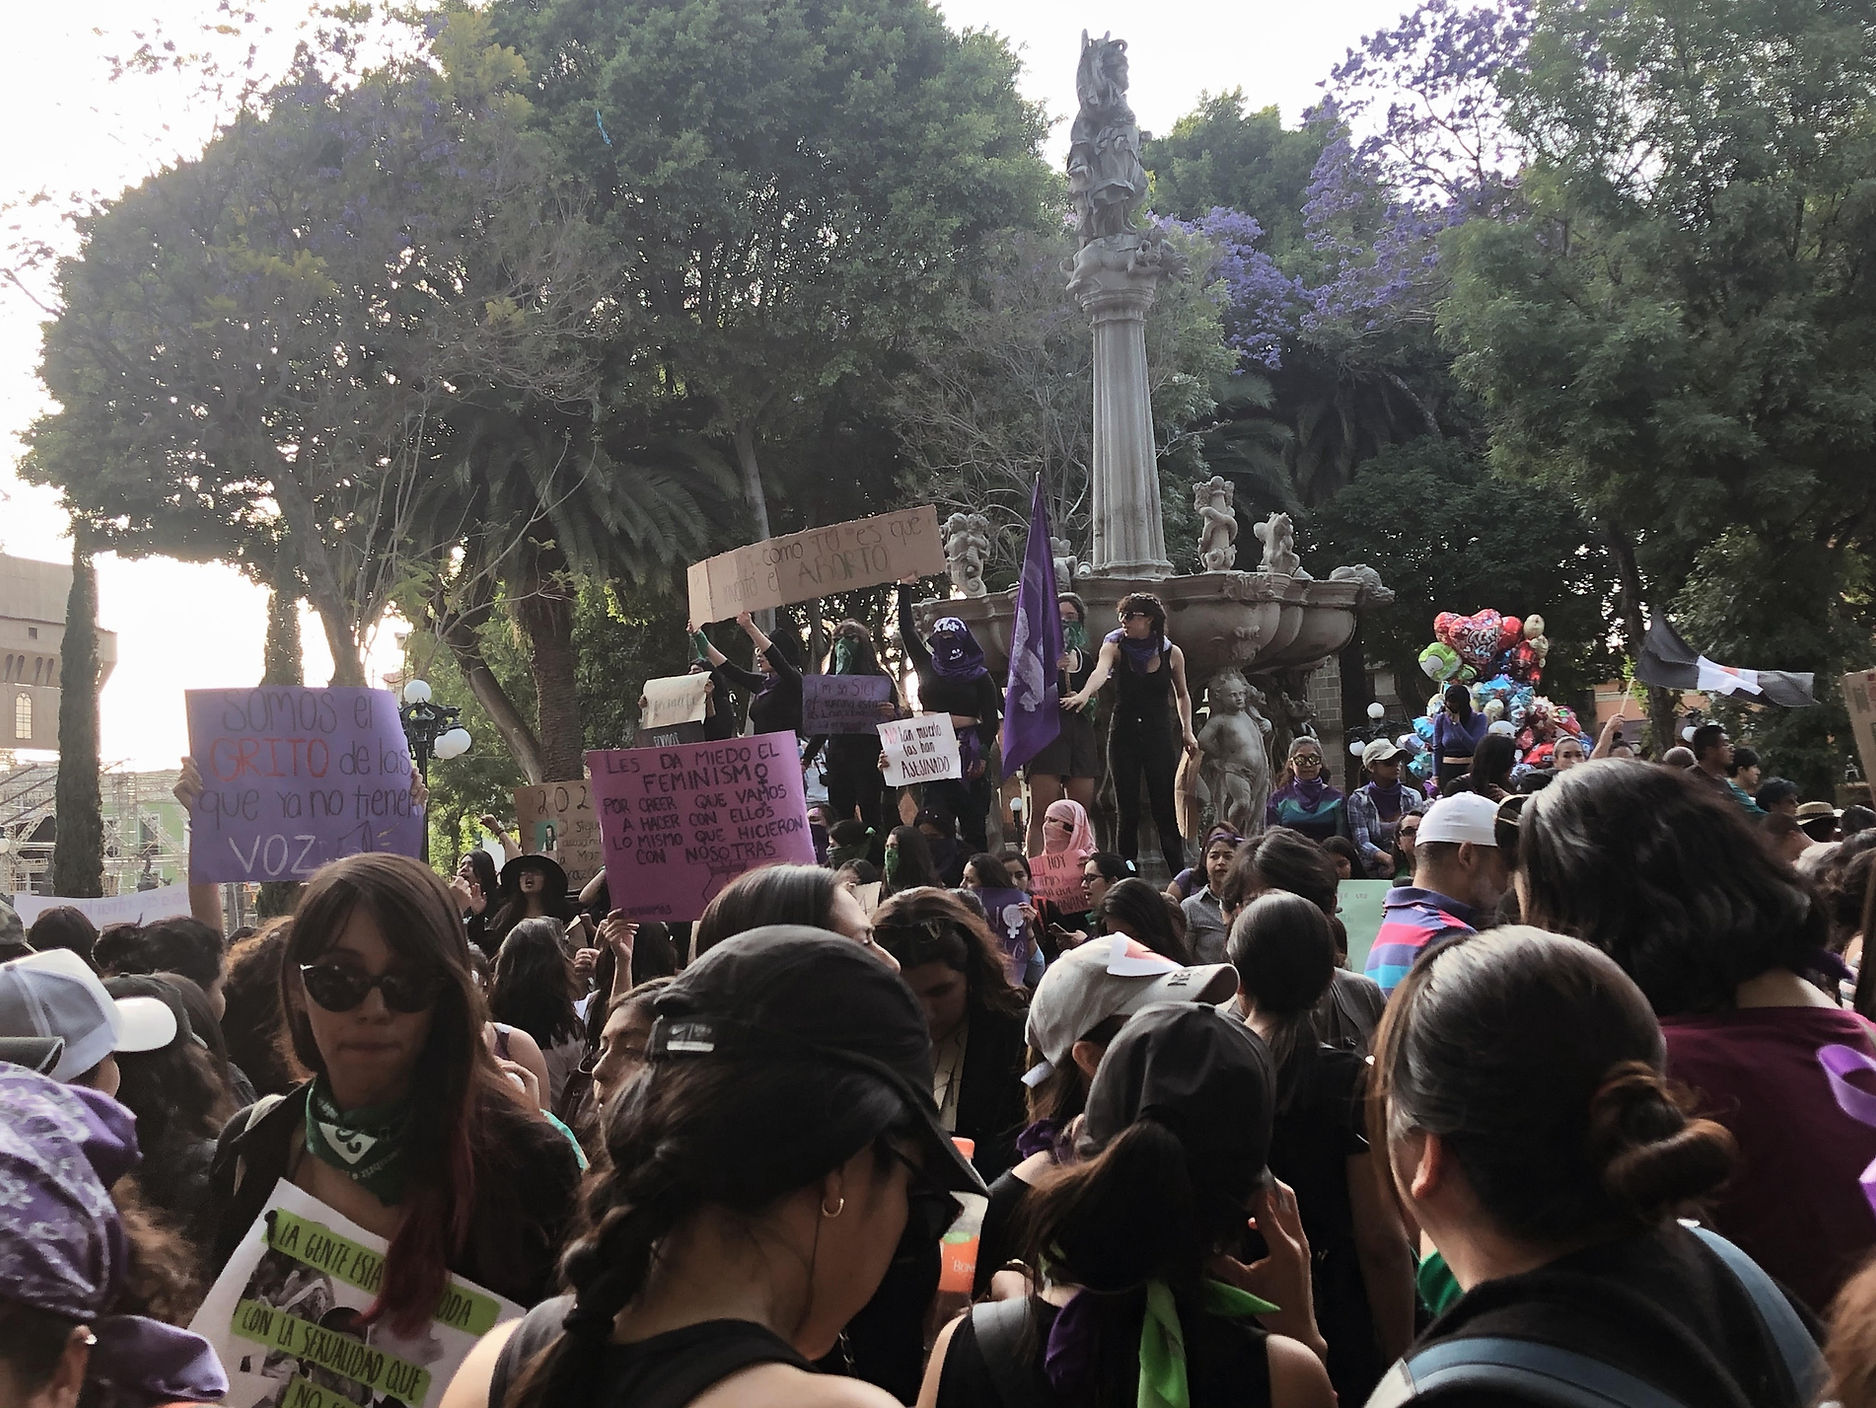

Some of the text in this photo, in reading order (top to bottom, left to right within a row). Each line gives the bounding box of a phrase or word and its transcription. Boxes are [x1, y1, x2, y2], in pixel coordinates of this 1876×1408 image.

[890, 516, 921, 546] que
[767, 568, 781, 593] el
[354, 694, 374, 729] el
[210, 737, 412, 782] GRITO de las
[606, 742, 780, 774] LES DA MIEDO EL
[199, 788, 260, 830] que
[310, 788, 344, 818] no
[603, 784, 787, 815] POR CREER QUE VAMOS
[613, 836, 632, 850] LO
[638, 833, 684, 848] MISMO
[695, 829, 726, 845] QUE
[738, 815, 803, 840] HICIERON
[623, 807, 775, 833] A HACER CON ELLOS
[229, 834, 316, 876] VOZ
[636, 840, 776, 865] CON NOSOTRAS
[1047, 854, 1066, 870] HOY
[279, 1221, 300, 1252] LA
[304, 1232, 350, 1275] GENTE
[242, 1306, 421, 1400] CON LA SEXUALIDAD QUE
[294, 1384, 322, 1408] NO
